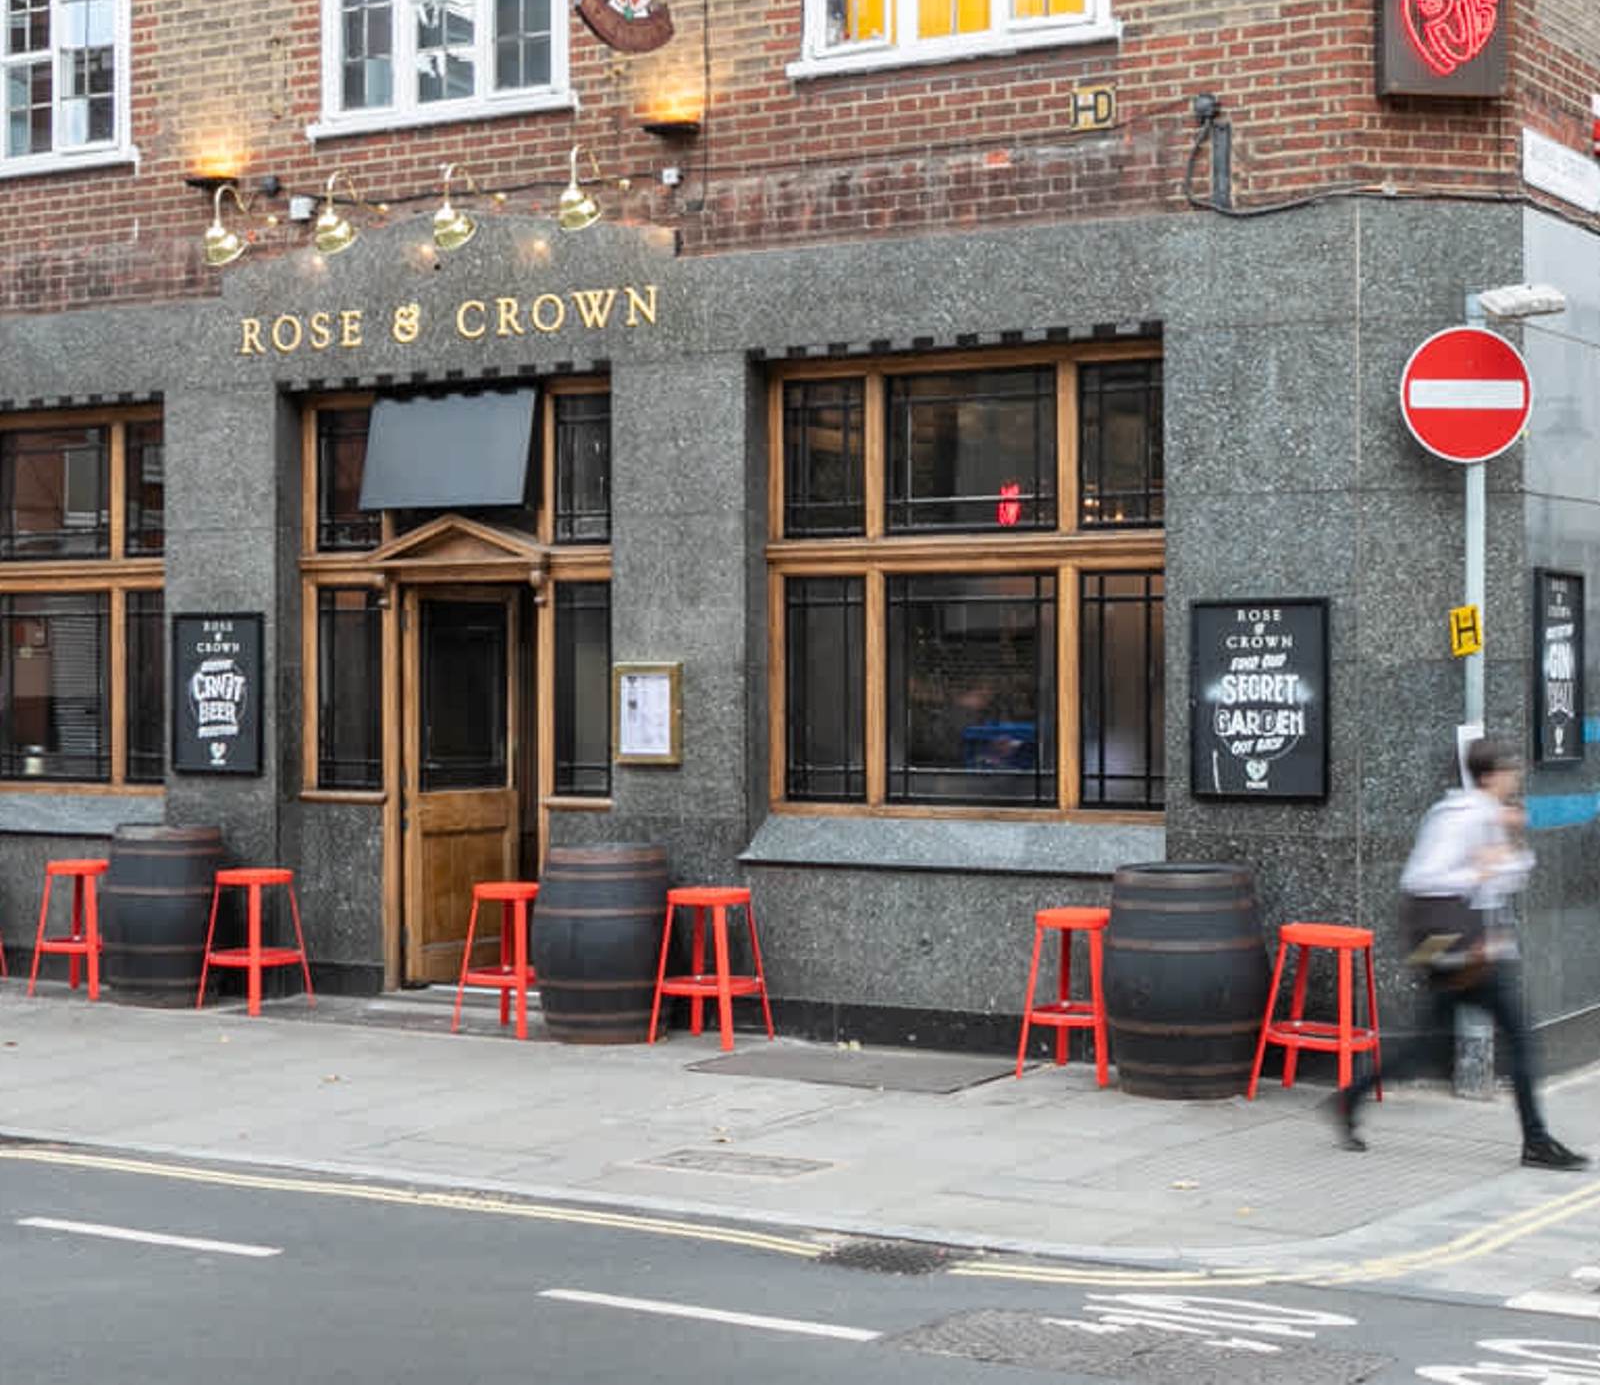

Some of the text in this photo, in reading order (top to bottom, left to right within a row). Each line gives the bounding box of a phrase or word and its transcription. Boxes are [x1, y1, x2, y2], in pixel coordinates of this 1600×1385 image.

[239, 284, 661, 356] ROSE & CROWN
[1237, 609, 1282, 622] ROSE
[1456, 609, 1479, 649] H
[196, 642, 240, 654] CROWN
[1226, 635, 1293, 649] CROWN
[1221, 674, 1299, 705] SECRET
[199, 701, 238, 724] BEER
[1214, 709, 1306, 736] GARDEN
